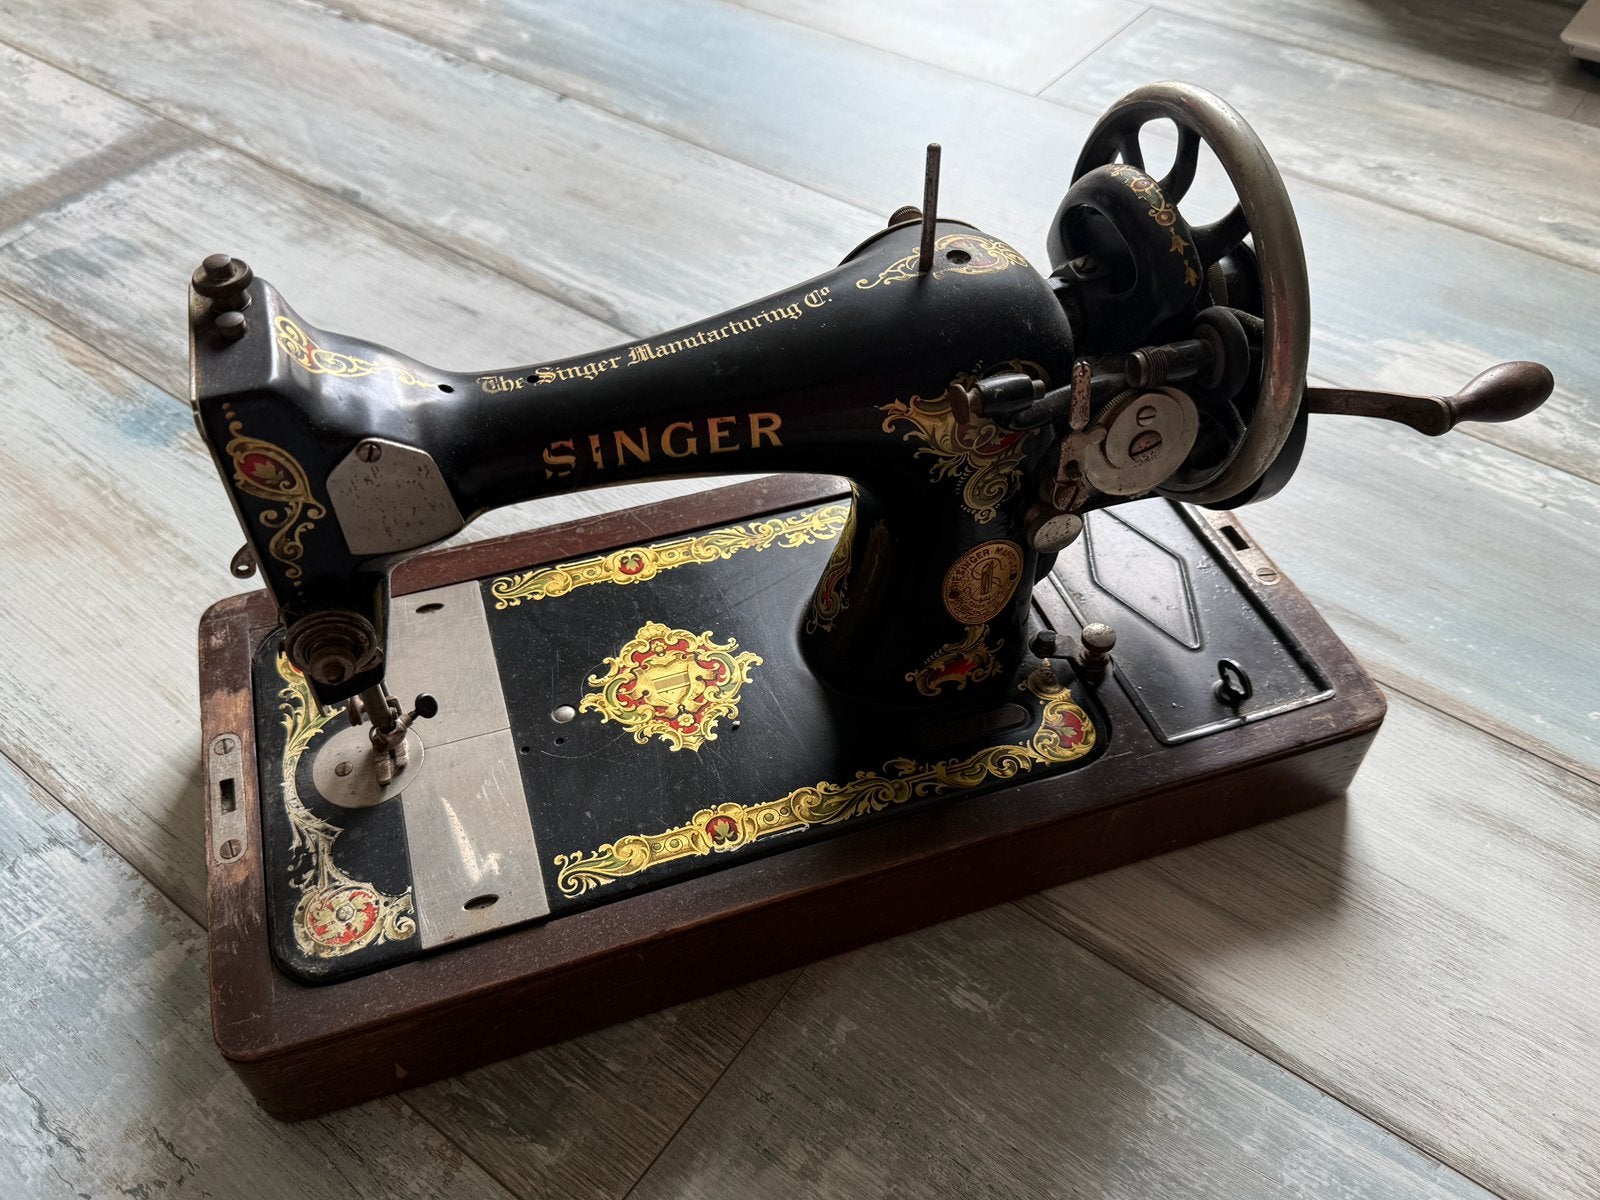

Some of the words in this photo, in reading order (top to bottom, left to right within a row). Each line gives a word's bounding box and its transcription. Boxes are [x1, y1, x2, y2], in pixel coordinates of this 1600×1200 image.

[475, 375, 525, 395] The
[533, 356, 622, 387] Singer
[627, 301, 803, 367] Manufacturing
[542, 411, 784, 480] SINGER
